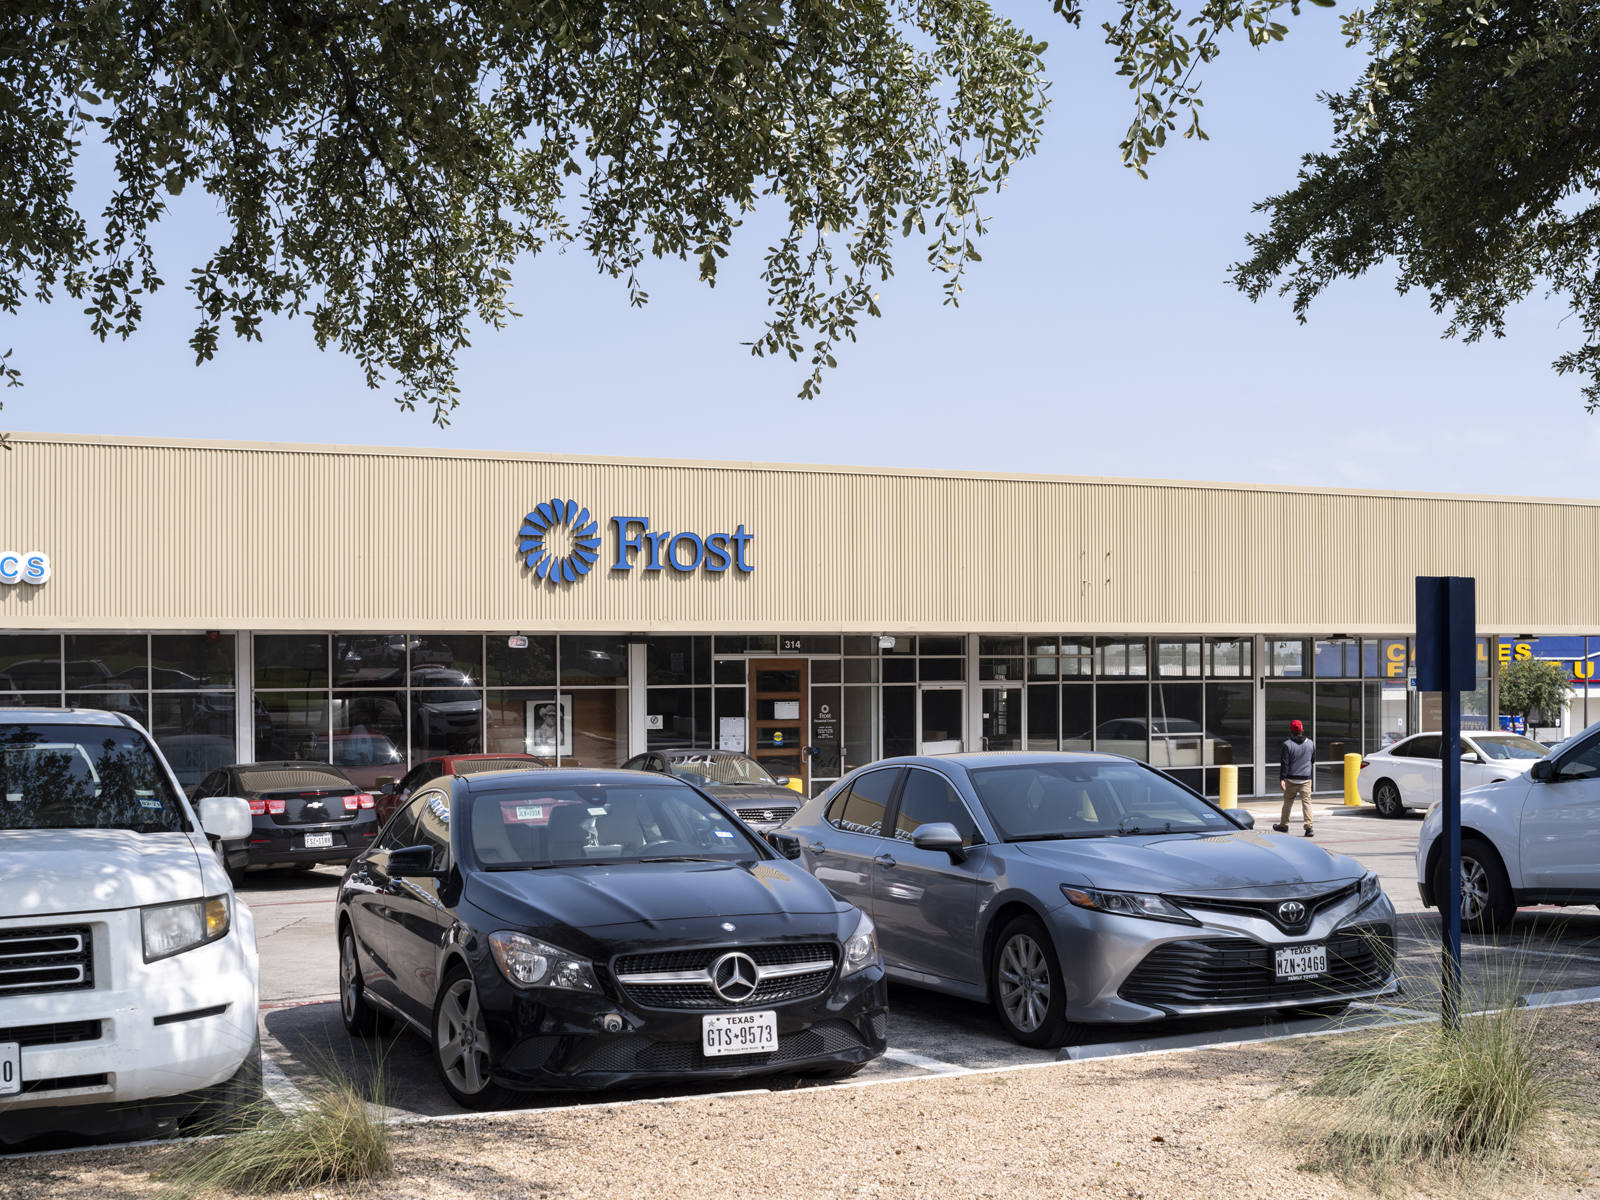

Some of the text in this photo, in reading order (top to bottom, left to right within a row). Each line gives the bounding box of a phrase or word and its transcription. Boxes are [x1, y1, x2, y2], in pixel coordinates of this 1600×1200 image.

[611, 515, 755, 573] Frost
[784, 640, 801, 649] 314
[1290, 946, 1312, 956] TEXAS
[726, 1015, 755, 1025] TEXAS
